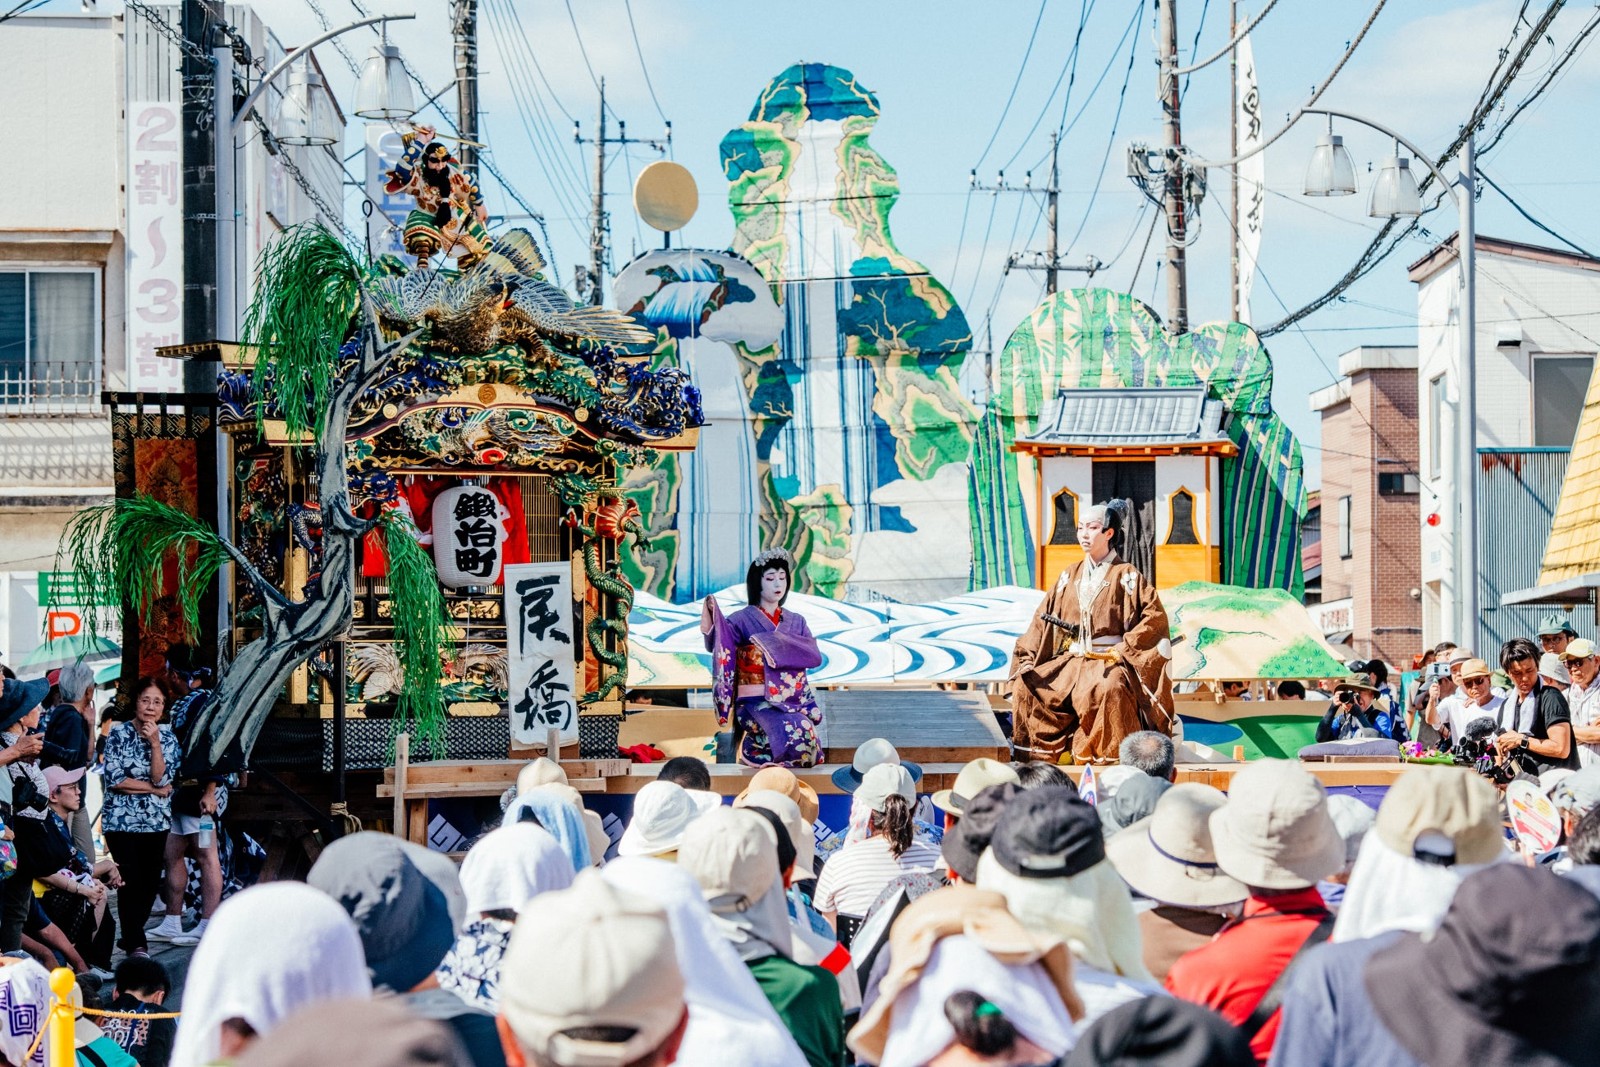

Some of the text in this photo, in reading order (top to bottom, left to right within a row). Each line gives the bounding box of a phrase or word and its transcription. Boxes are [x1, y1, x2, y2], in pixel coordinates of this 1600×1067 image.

[453, 492, 497, 577] 鍛冶町
[48, 611, 81, 640] P
